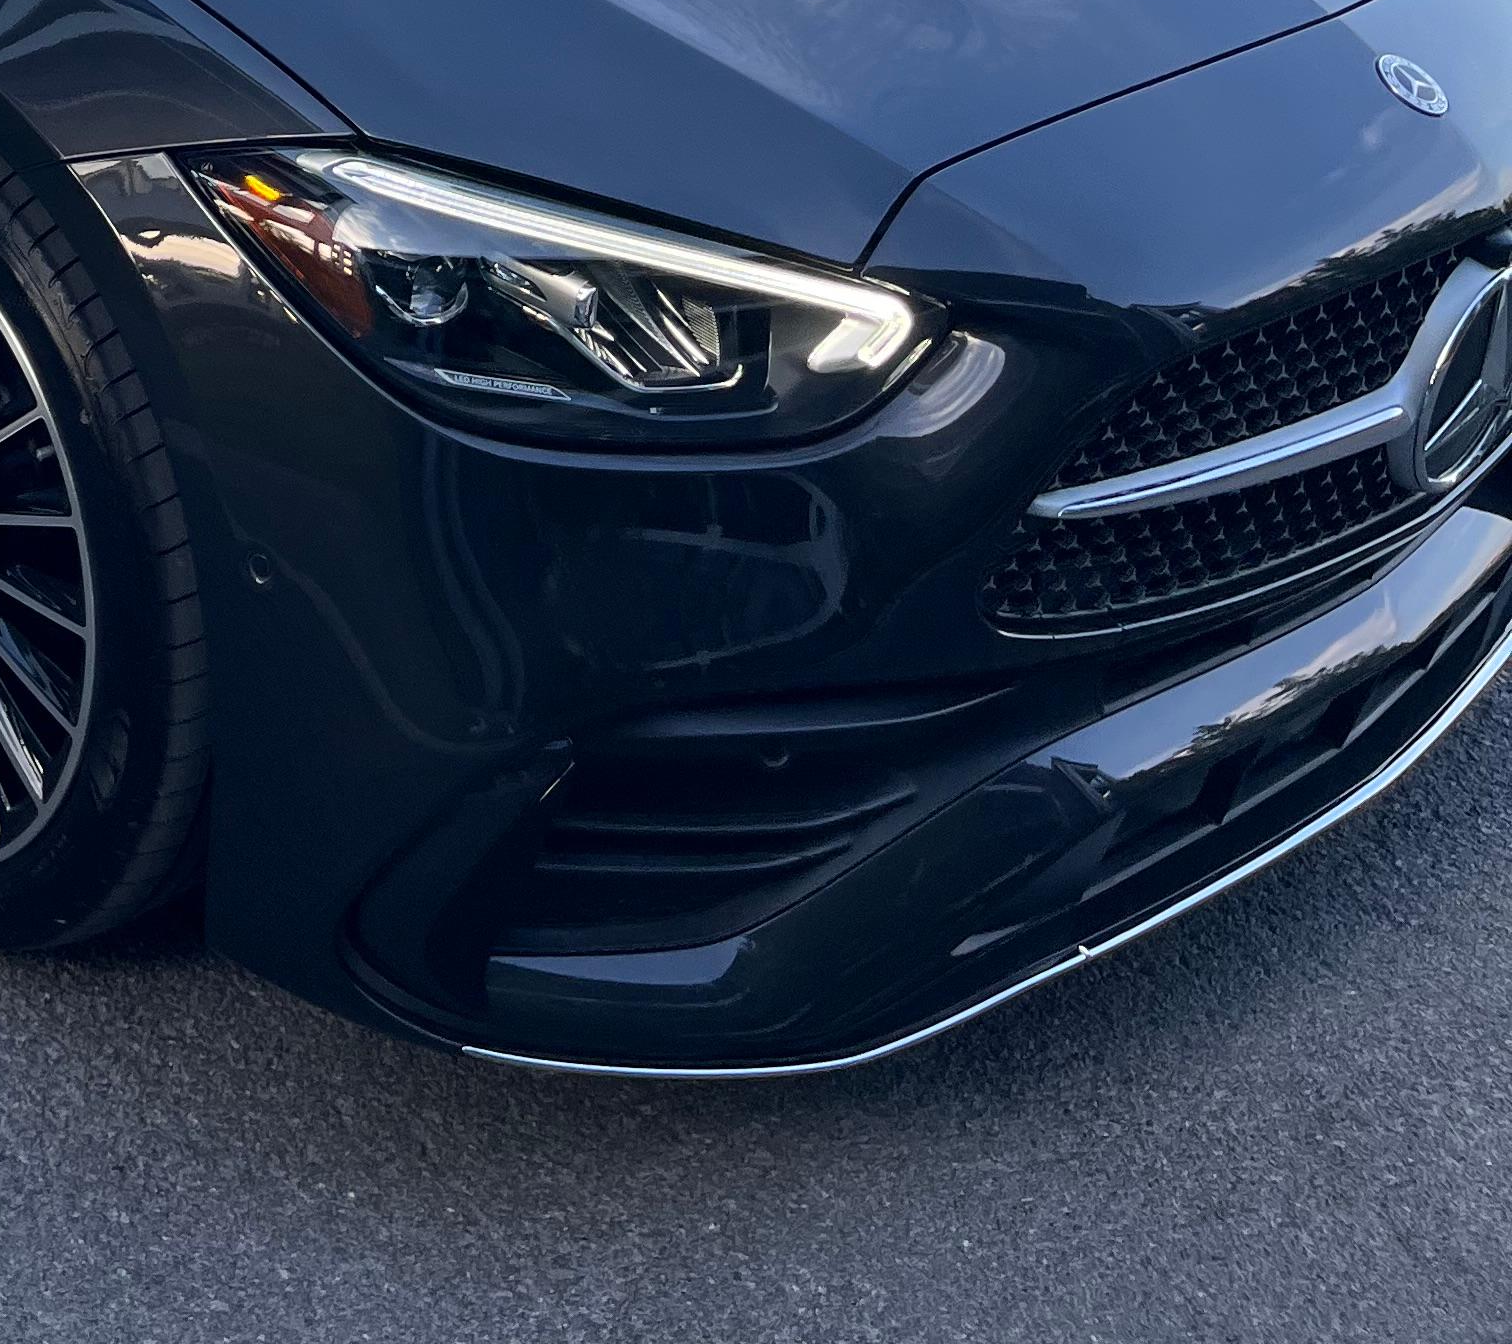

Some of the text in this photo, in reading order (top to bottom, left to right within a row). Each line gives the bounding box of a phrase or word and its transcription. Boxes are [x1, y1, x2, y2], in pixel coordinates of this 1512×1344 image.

[454, 374, 553, 396] LED HIGH PERFORMANCE
